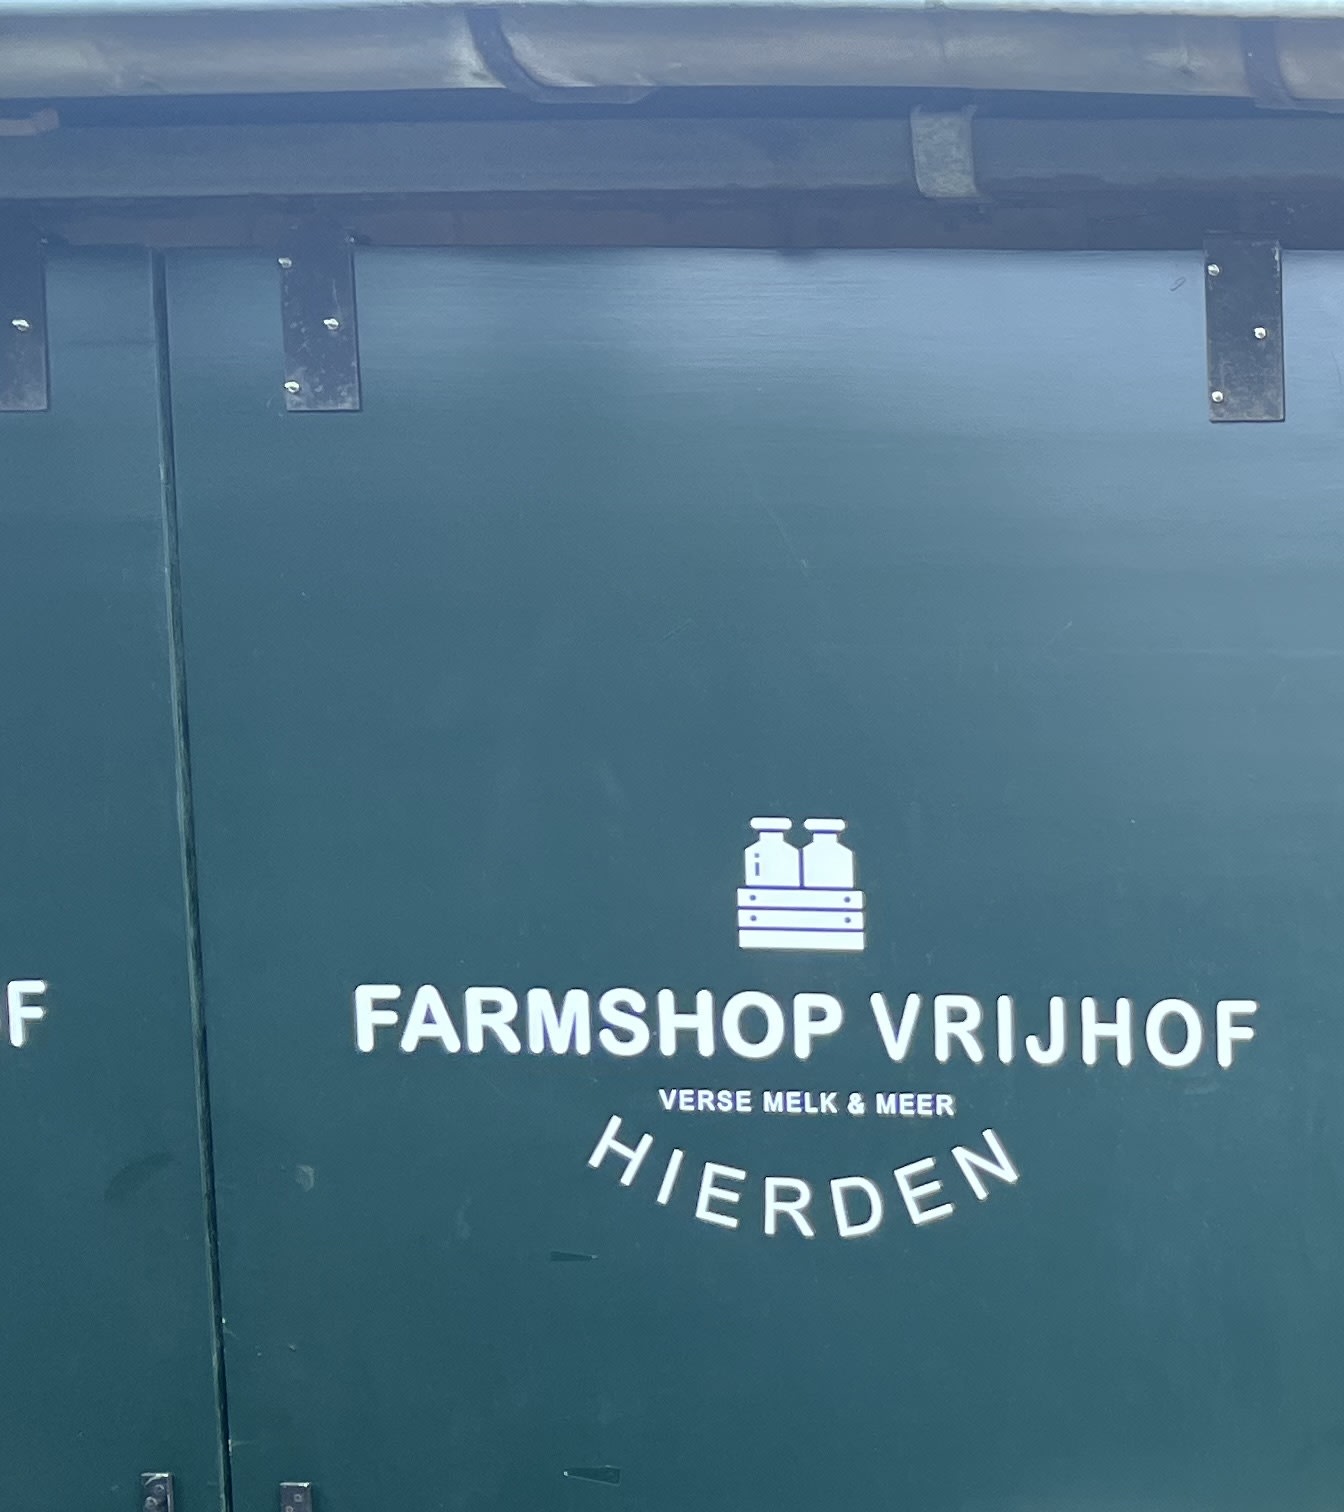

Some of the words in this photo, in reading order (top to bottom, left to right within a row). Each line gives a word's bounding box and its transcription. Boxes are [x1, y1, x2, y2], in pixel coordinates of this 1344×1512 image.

[354, 983, 844, 1060] FARMSHOP
[869, 991, 1260, 1069] VRIJHOF
[657, 1088, 753, 1113] VERSE
[762, 1090, 839, 1115] MELK
[846, 1091, 866, 1116] &
[875, 1092, 956, 1117] MEER
[586, 1113, 1020, 1239] HIERDEN
